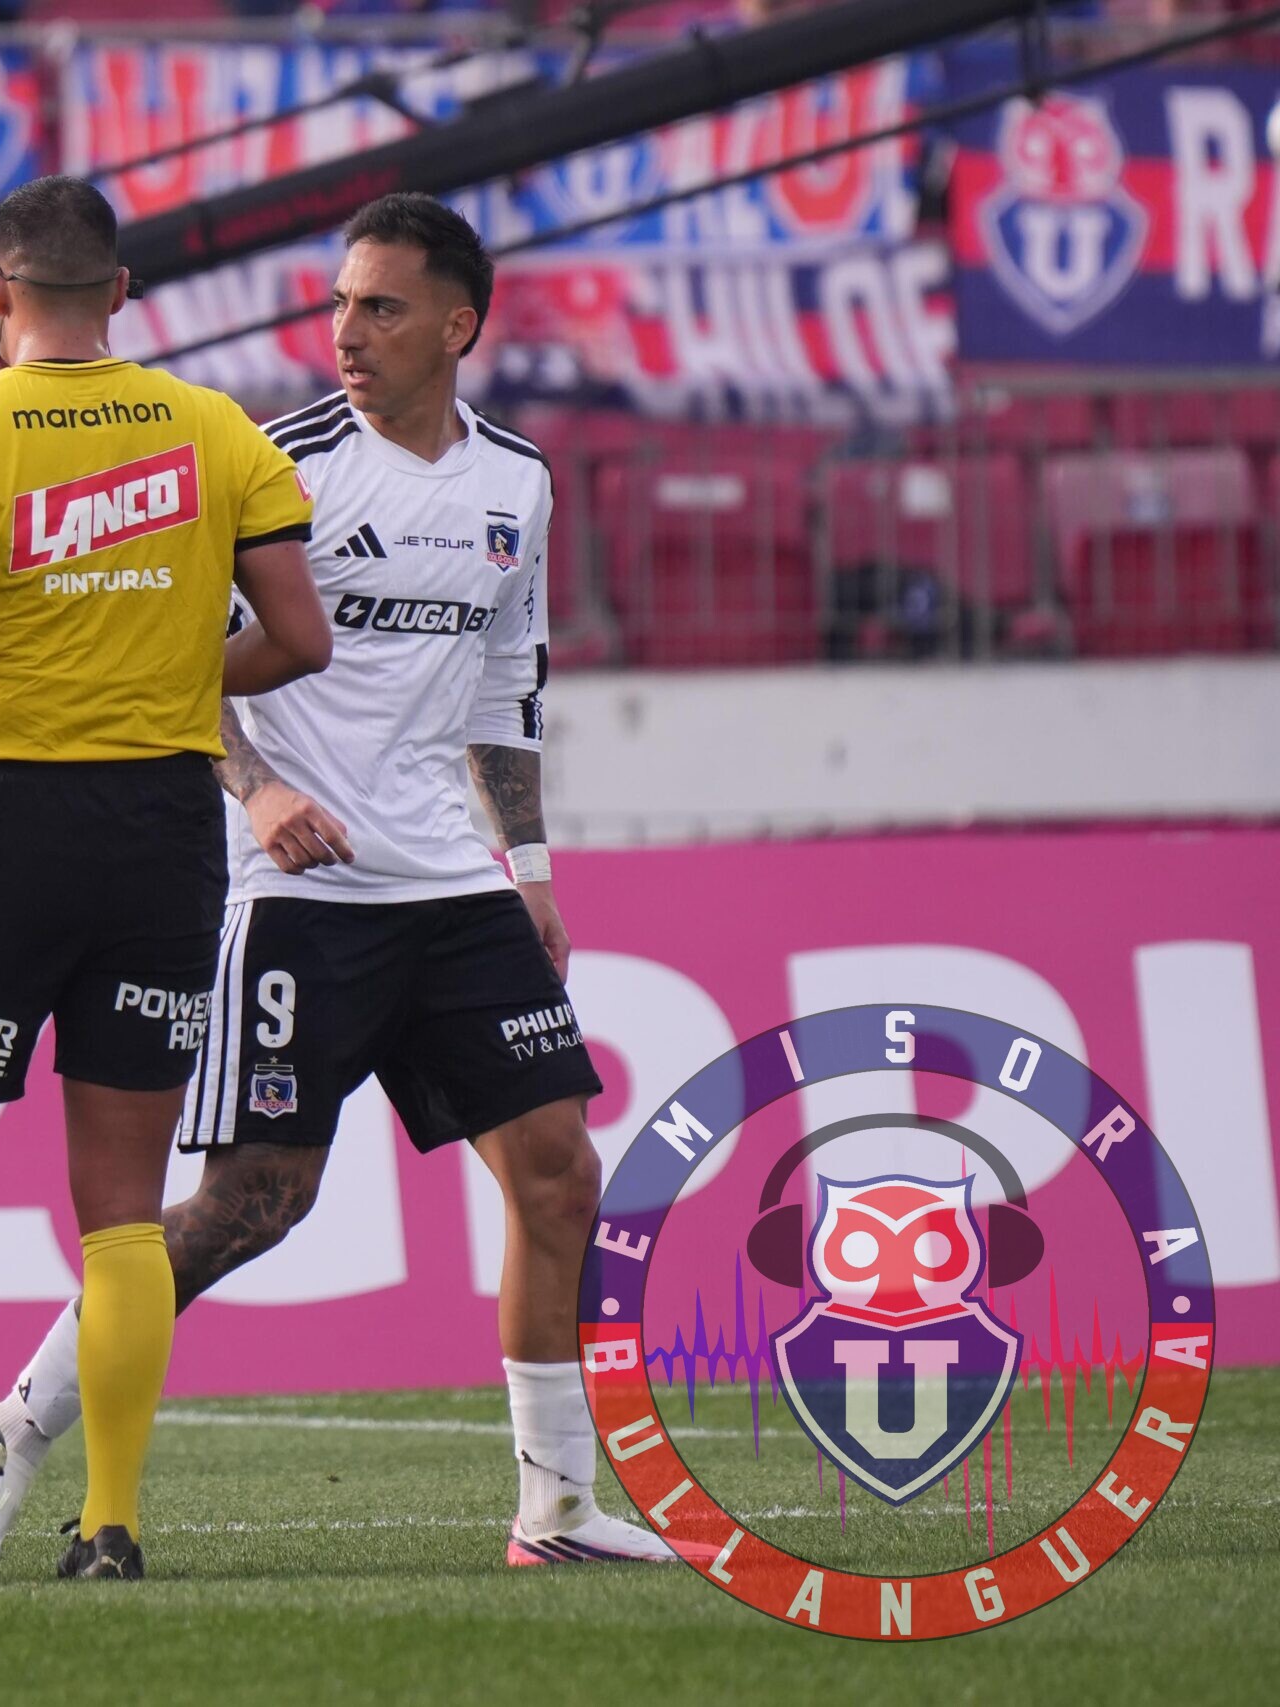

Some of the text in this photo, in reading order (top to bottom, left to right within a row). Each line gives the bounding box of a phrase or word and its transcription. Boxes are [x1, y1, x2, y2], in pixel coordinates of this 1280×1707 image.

[12, 400, 173, 430] marathon
[30, 468, 179, 564] LANCO
[394, 535, 474, 550] JETOUR
[44, 567, 173, 596] PINTURAS
[510, 1040, 534, 1061] TV
[540, 1036, 554, 1053] &
